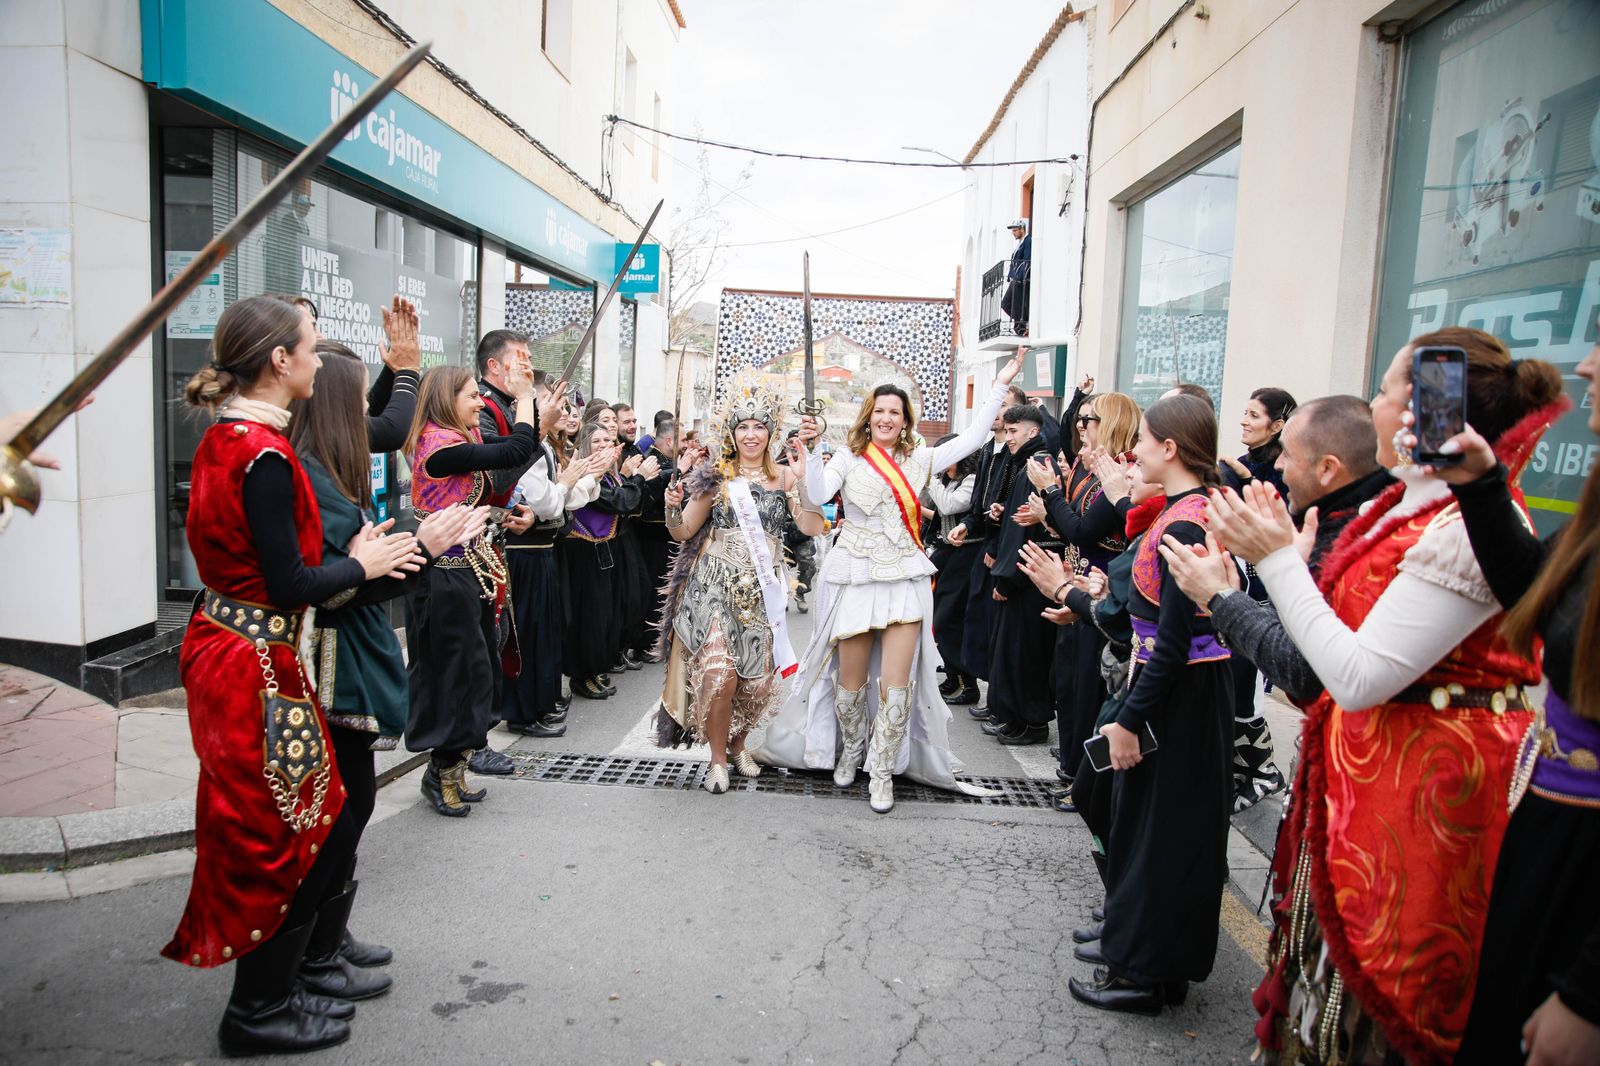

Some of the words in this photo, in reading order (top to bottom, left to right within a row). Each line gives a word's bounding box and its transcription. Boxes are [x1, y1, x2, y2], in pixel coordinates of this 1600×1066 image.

[367, 109, 441, 177] cajamar
[559, 221, 588, 257] cajamar
[301, 269, 311, 291] A
[314, 272, 329, 295] LA
[332, 276, 354, 299] RED
[398, 275, 406, 293] SI
[408, 278, 426, 297] ERES
[320, 299, 371, 323] NEGOCIO
[317, 317, 388, 346] TERNACIONAL
